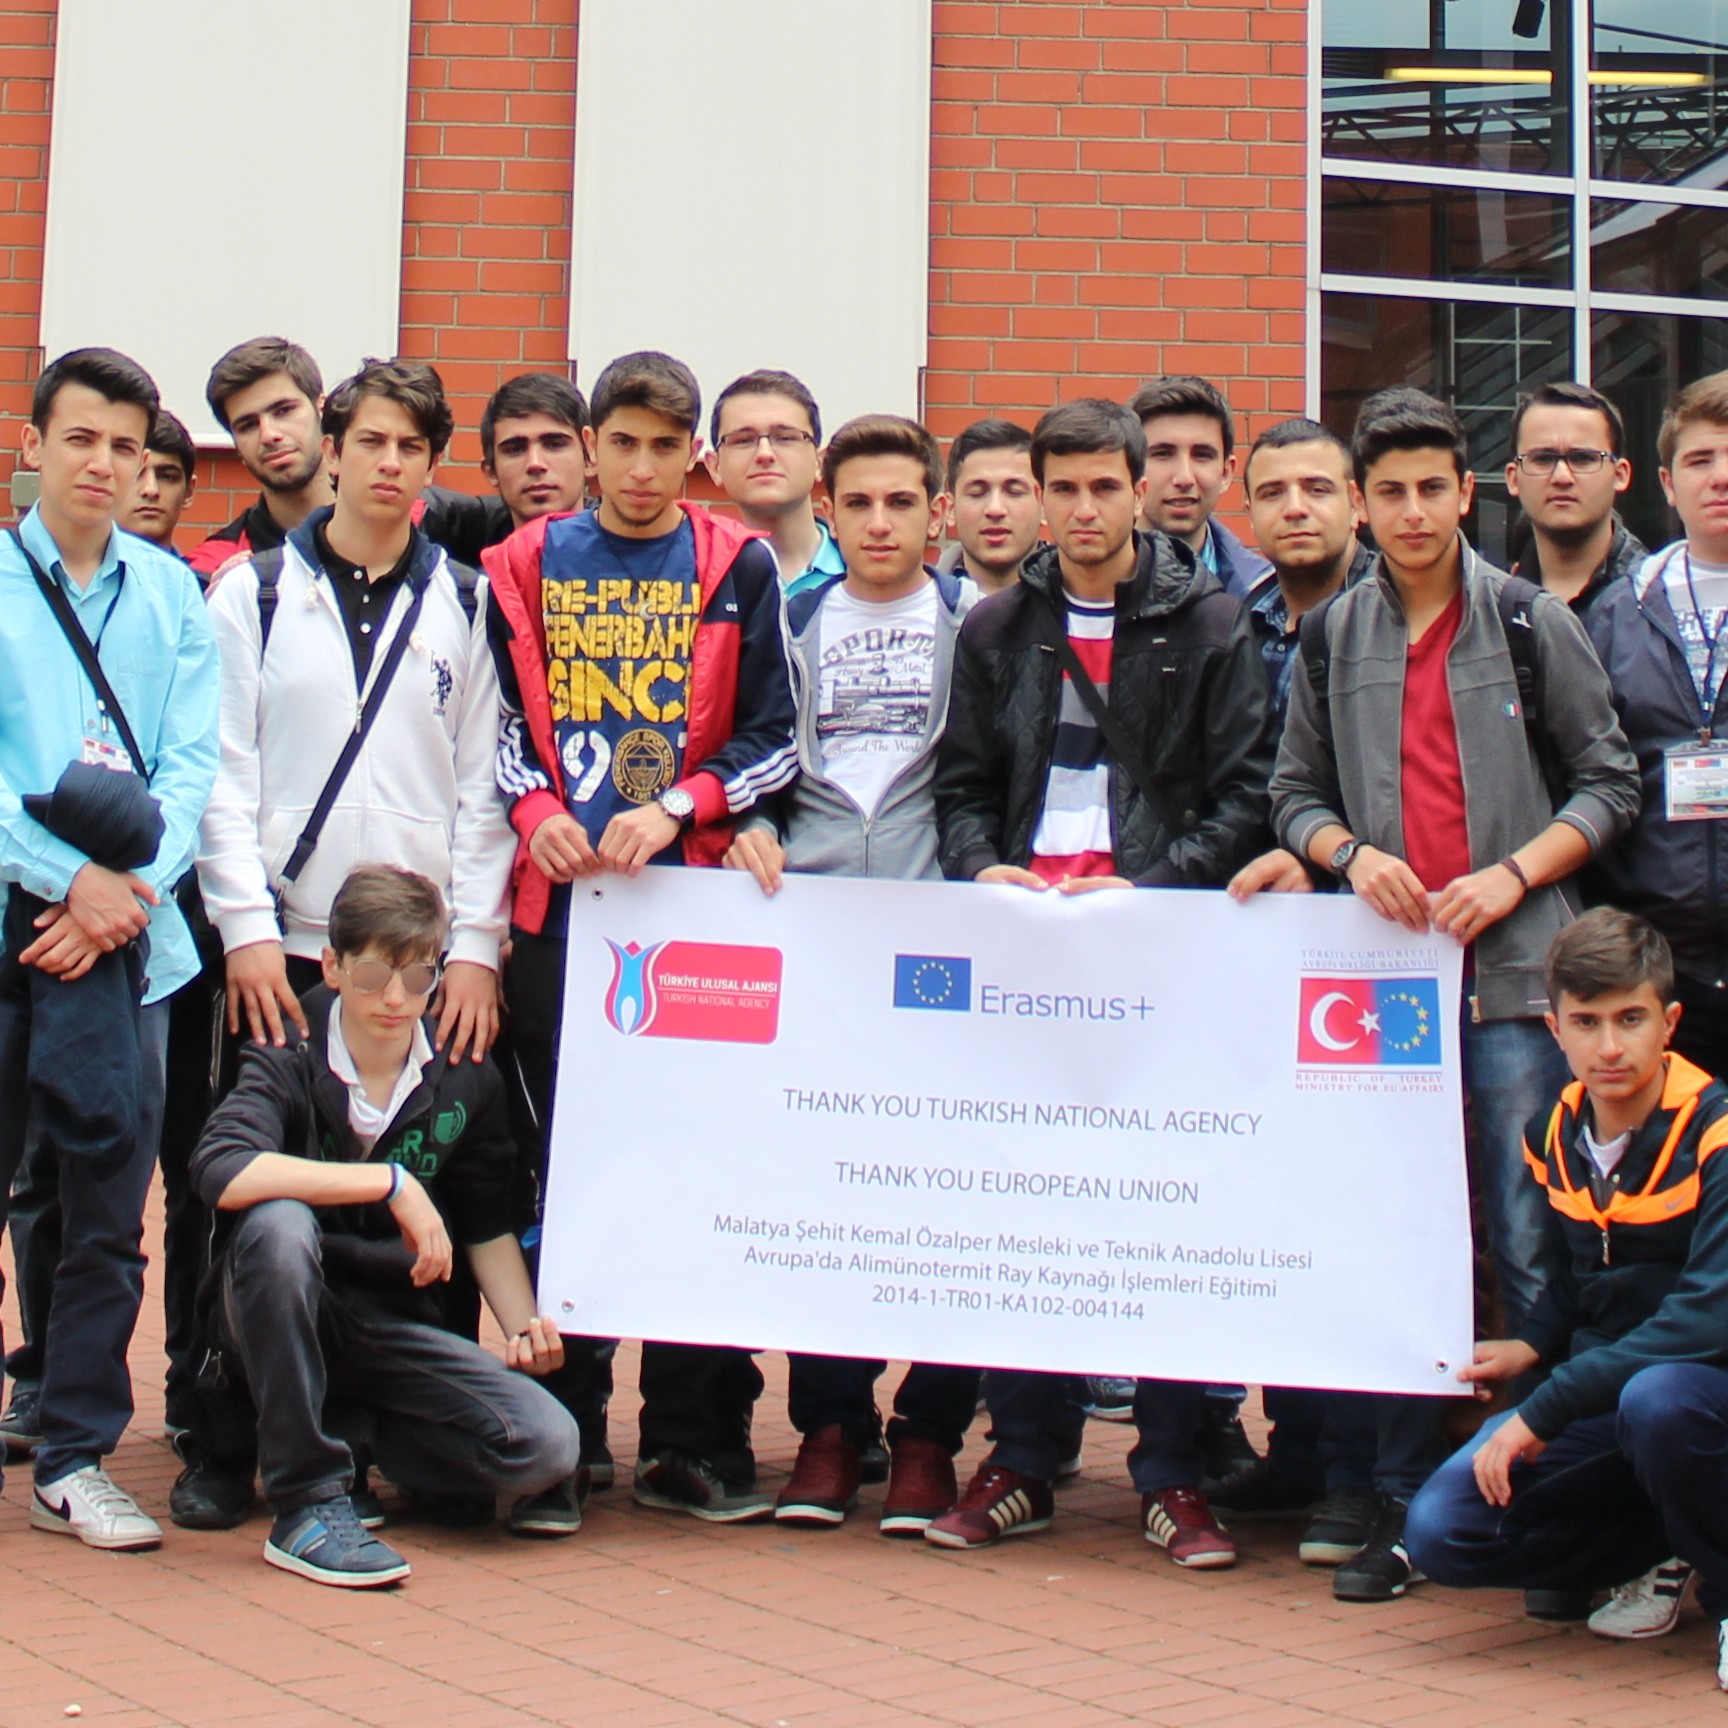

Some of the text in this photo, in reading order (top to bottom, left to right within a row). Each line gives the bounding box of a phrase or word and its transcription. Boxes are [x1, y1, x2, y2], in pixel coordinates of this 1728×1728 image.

[543, 613, 699, 659] FENERBAH
[547, 658, 692, 722] SINC
[658, 974, 778, 993] TÜRKİYE ULUSAL AJANSI
[663, 992, 771, 1009] TURKISH NATIONAL AGENCY
[980, 984, 1155, 1022] Erasmus+
[1295, 1083, 1445, 1093] MINISTRY FOR EU AFFAIRS
[1296, 1073, 1443, 1084] REPUBLIC OF TURKEY
[783, 1087, 1263, 1136] THANK YOU TURKISH NATIONAL AGENCY
[834, 1161, 1199, 1204] THANK YOU EUROPEAN UNION
[713, 1214, 1313, 1270] Malatya Şehit Kemal Özalper Mesleki ve Teknik Anadolu Lisesi
[744, 1246, 1278, 1300] Avrupa'da Alimünotermit Ray Kaynağı İşlemleri Eğitimi
[872, 1284, 1145, 1320] 2014-1-TR01-KA102-004144
